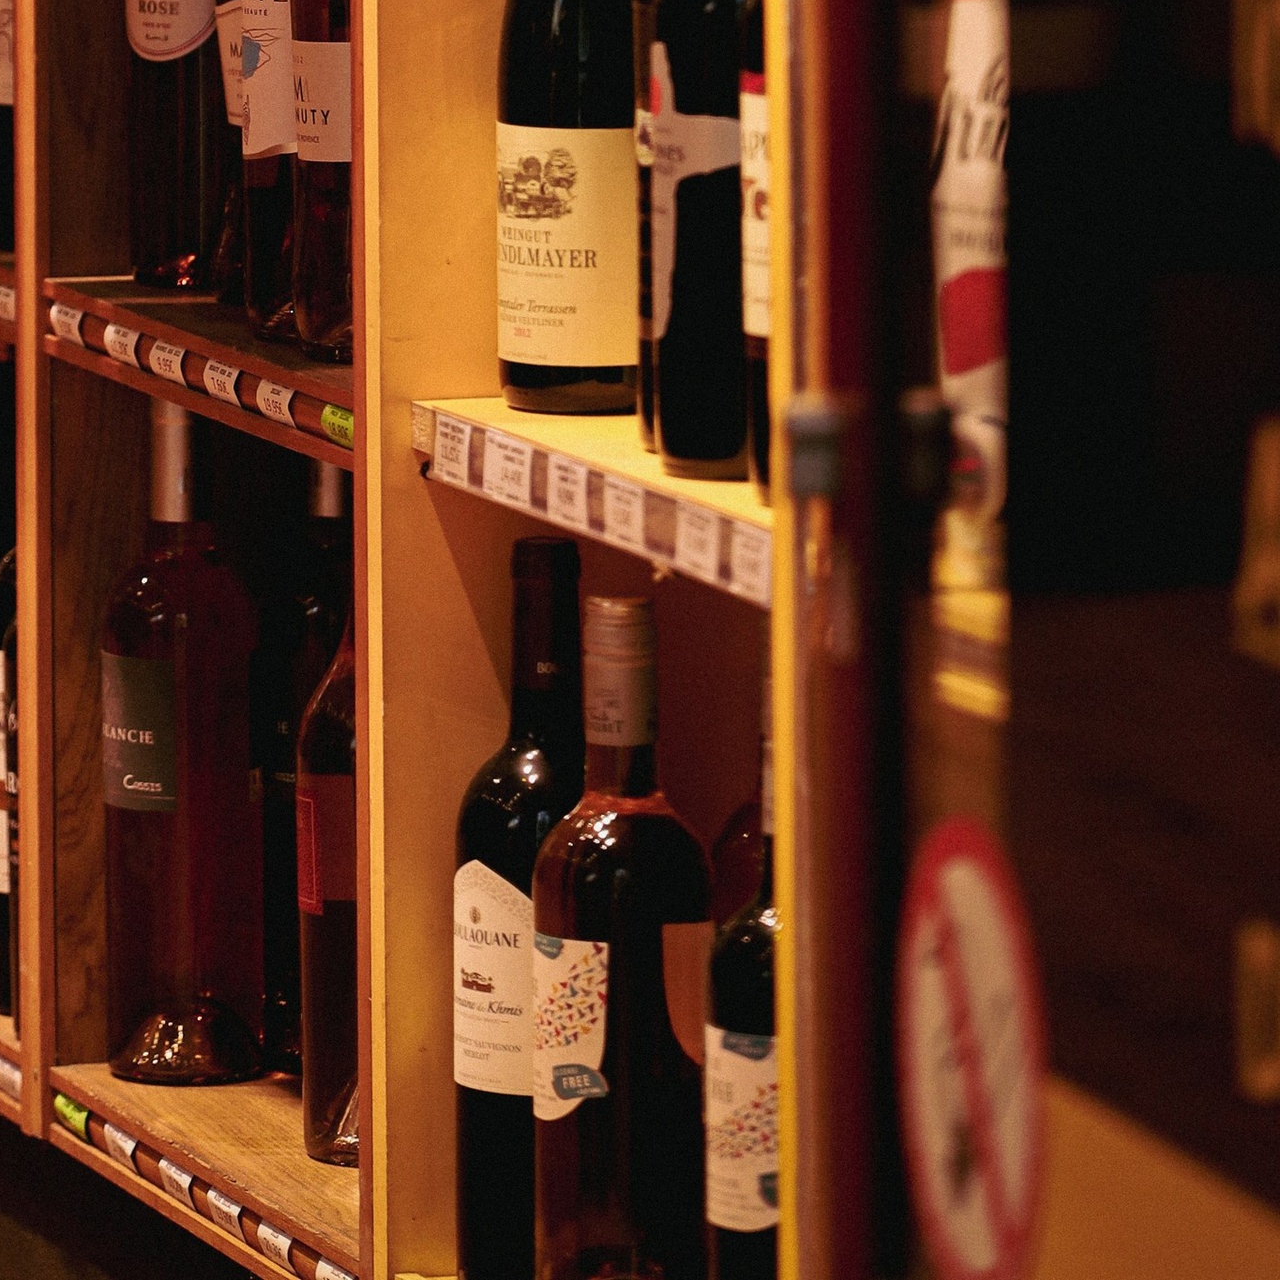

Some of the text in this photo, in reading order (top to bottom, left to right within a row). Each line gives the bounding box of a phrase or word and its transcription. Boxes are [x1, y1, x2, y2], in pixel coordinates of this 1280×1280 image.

[295, 107, 331, 126] NUTY
[498, 242, 598, 269] NDLMAYER
[562, 1073, 592, 1089] FREE
